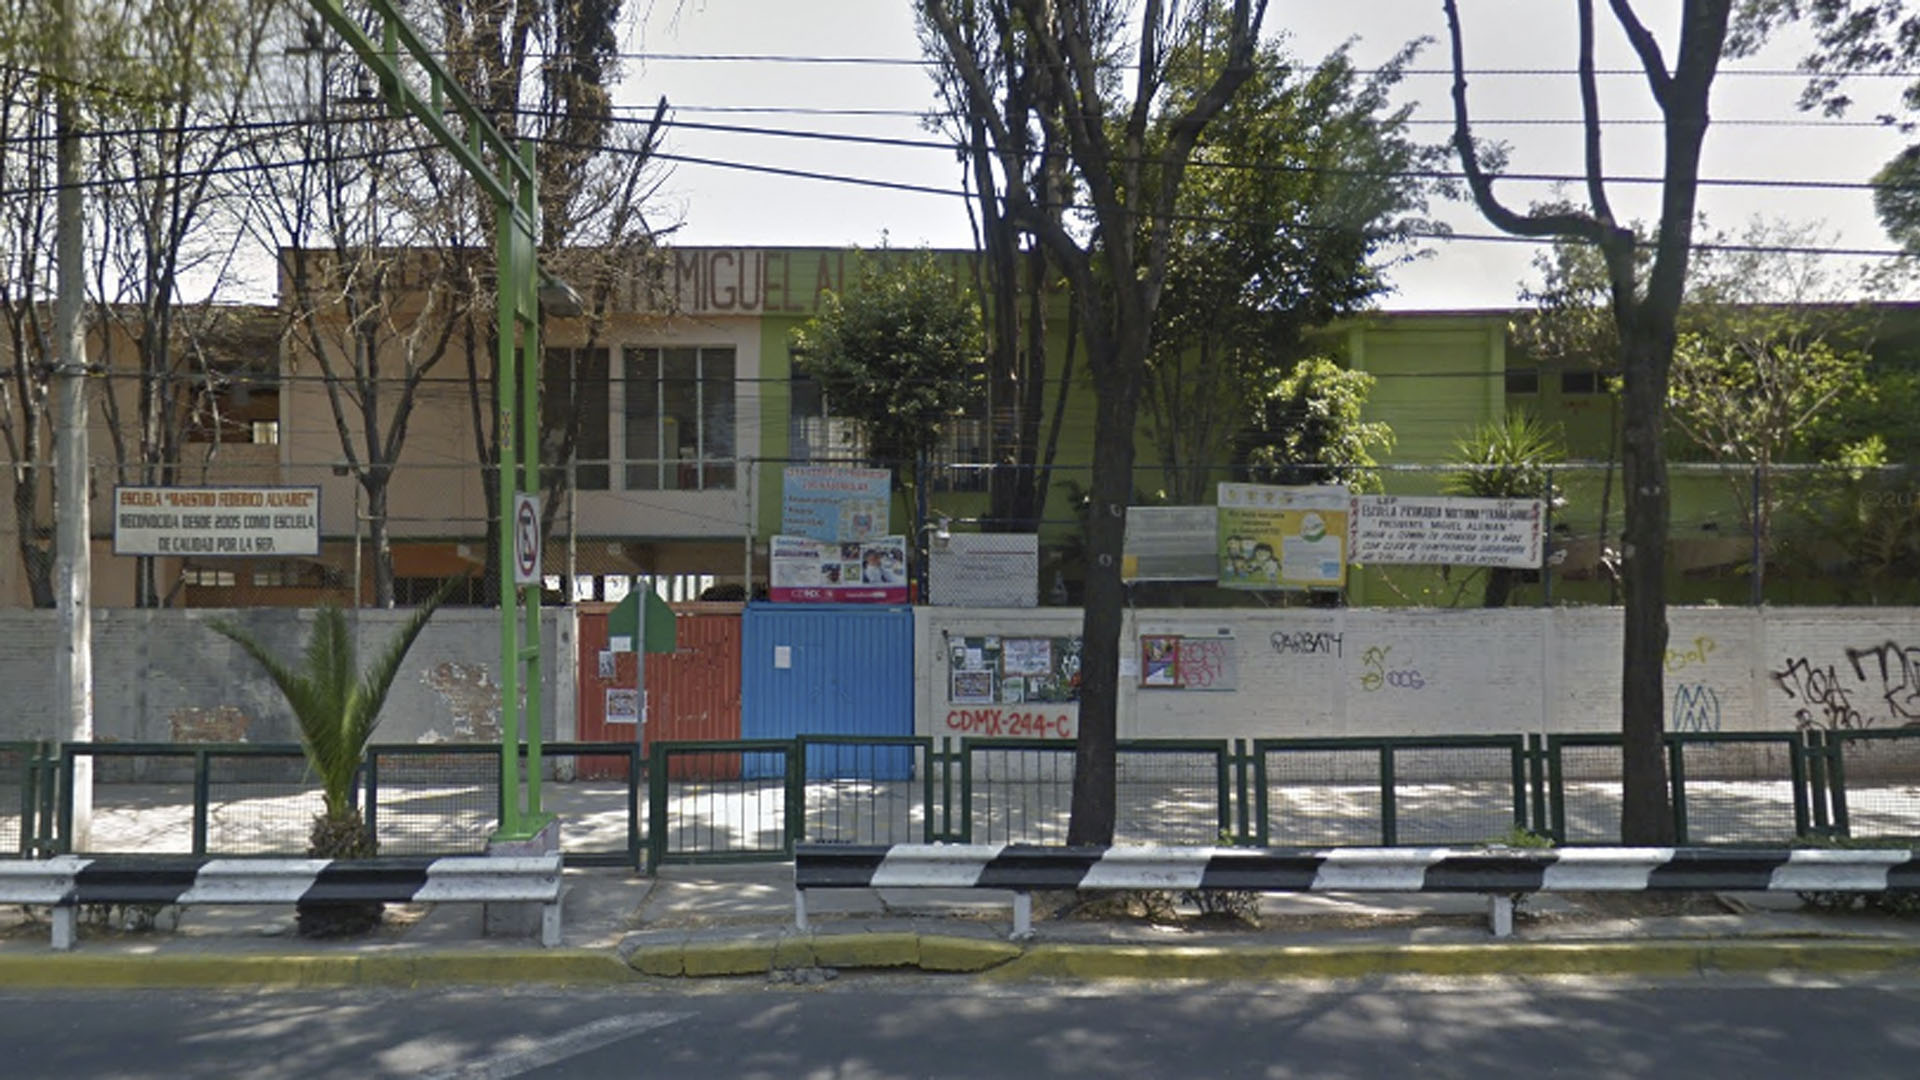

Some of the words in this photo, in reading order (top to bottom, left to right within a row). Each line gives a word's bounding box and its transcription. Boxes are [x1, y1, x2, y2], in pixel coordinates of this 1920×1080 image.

[675, 250, 805, 312] MIGUEL
[120, 491, 162, 507] ESCUELA
[218, 492, 263, 508] FEDERICO
[1362, 505, 1397, 518] ESCUELA
[1399, 505, 1441, 519] PRIMARIA
[120, 513, 179, 529] RECONOCIDA
[182, 513, 211, 529] DESDE
[214, 514, 241, 530] 2005
[243, 514, 271, 530] COMO
[273, 514, 315, 530] ESCUELA
[1430, 521, 1462, 531] MIGUEL
[158, 536, 171, 551] DE
[173, 536, 214, 552] CALIDAD
[217, 537, 237, 552] POR
[239, 537, 253, 552] LA
[946, 709, 1071, 738] CDMX-244-C
